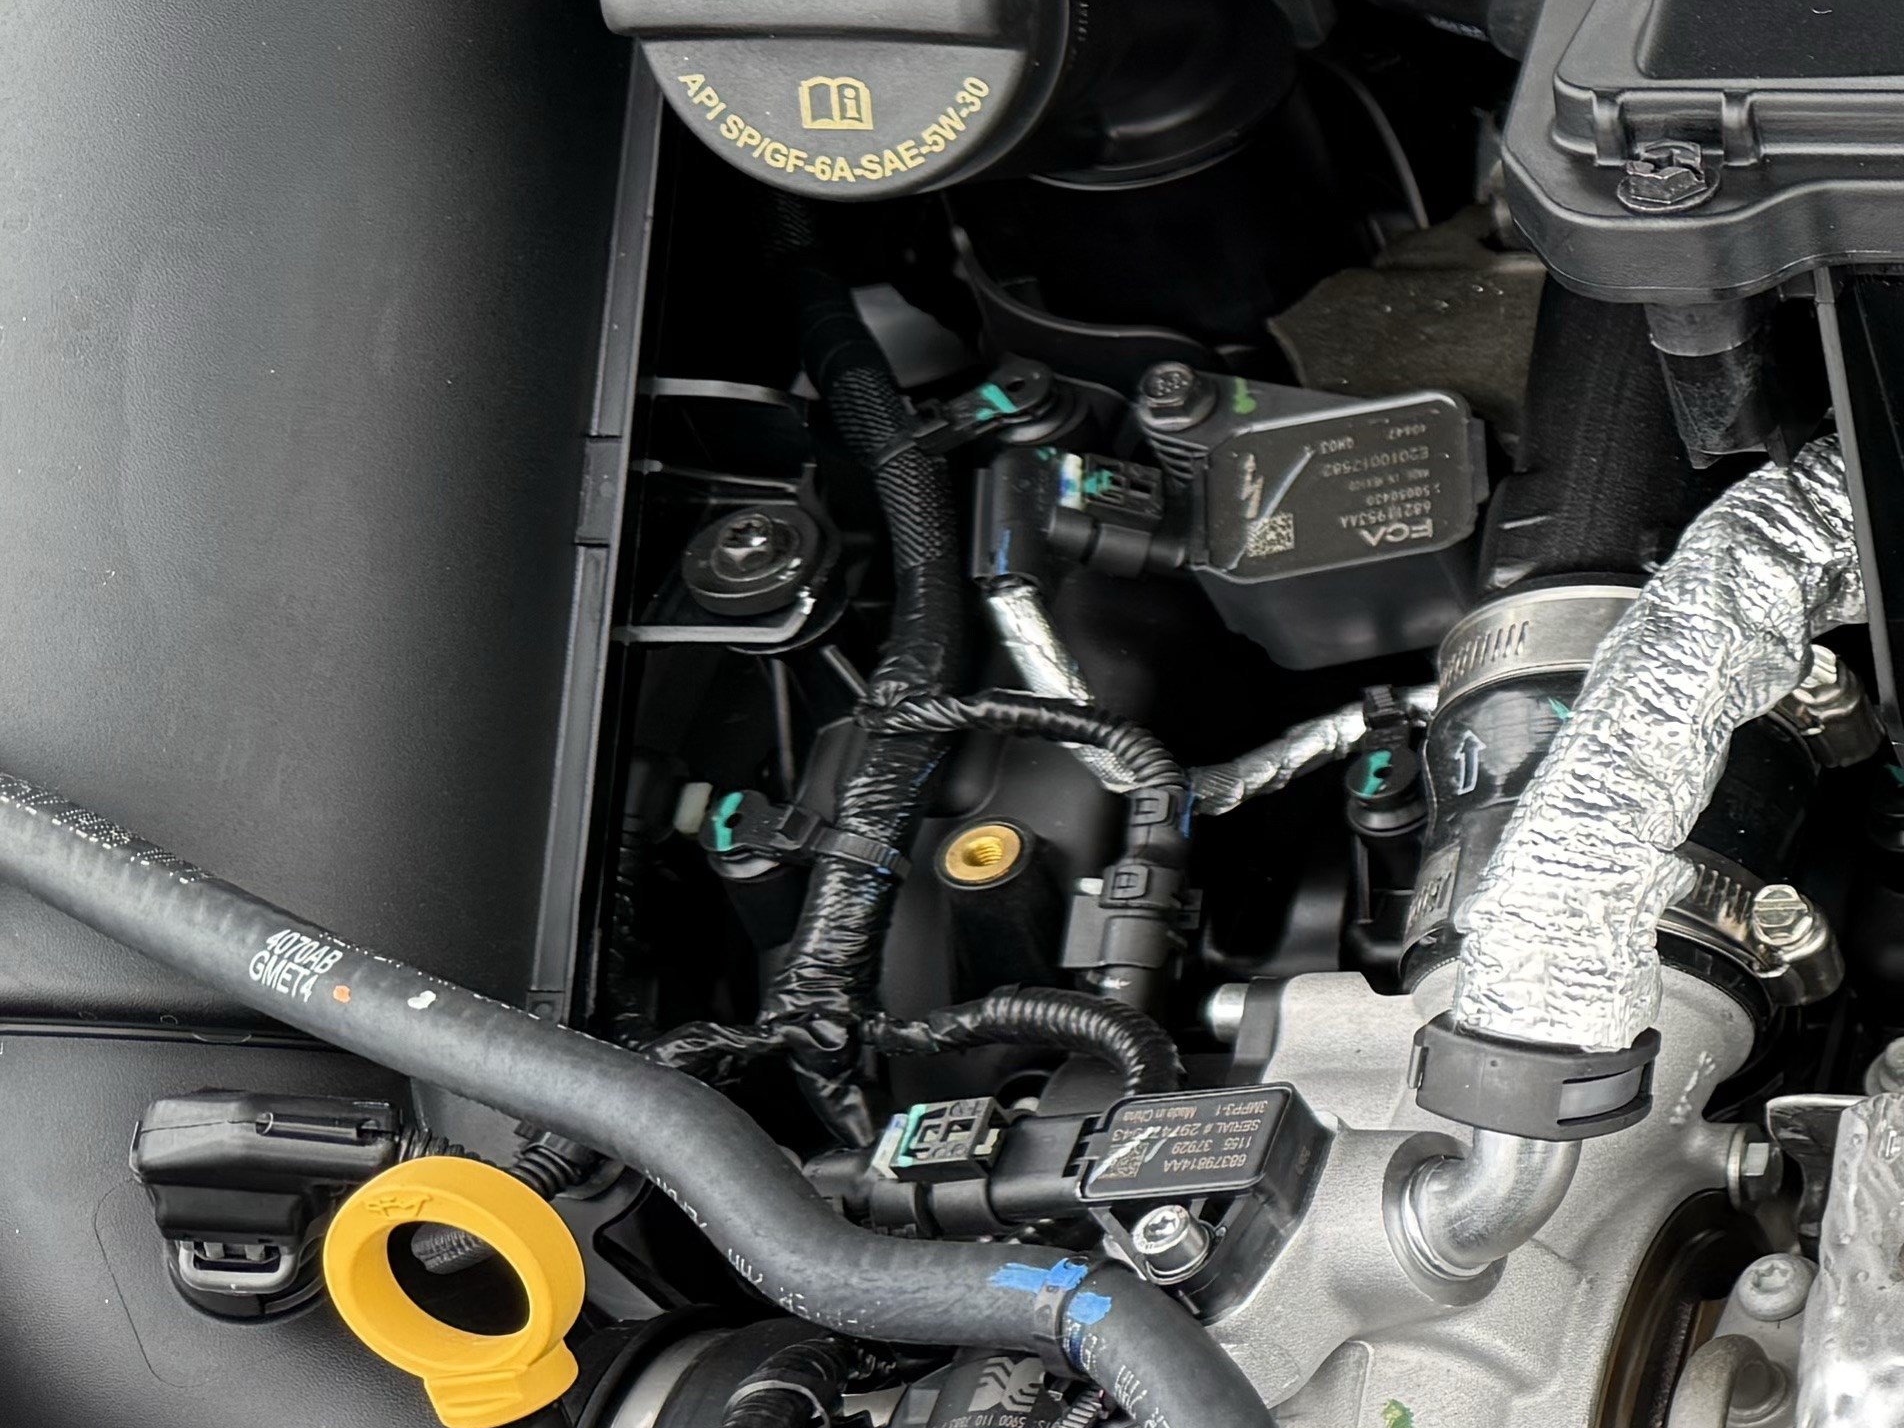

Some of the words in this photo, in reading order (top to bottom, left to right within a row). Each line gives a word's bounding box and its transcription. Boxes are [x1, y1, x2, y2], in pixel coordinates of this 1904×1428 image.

[678, 72, 727, 121] API
[1358, 518, 1433, 547] FCA
[1122, 1108, 1153, 1121] China
[1154, 1107, 1166, 1119] in
[1166, 1106, 1197, 1118] Made
[1216, 1119, 1261, 1131] SERIAL
